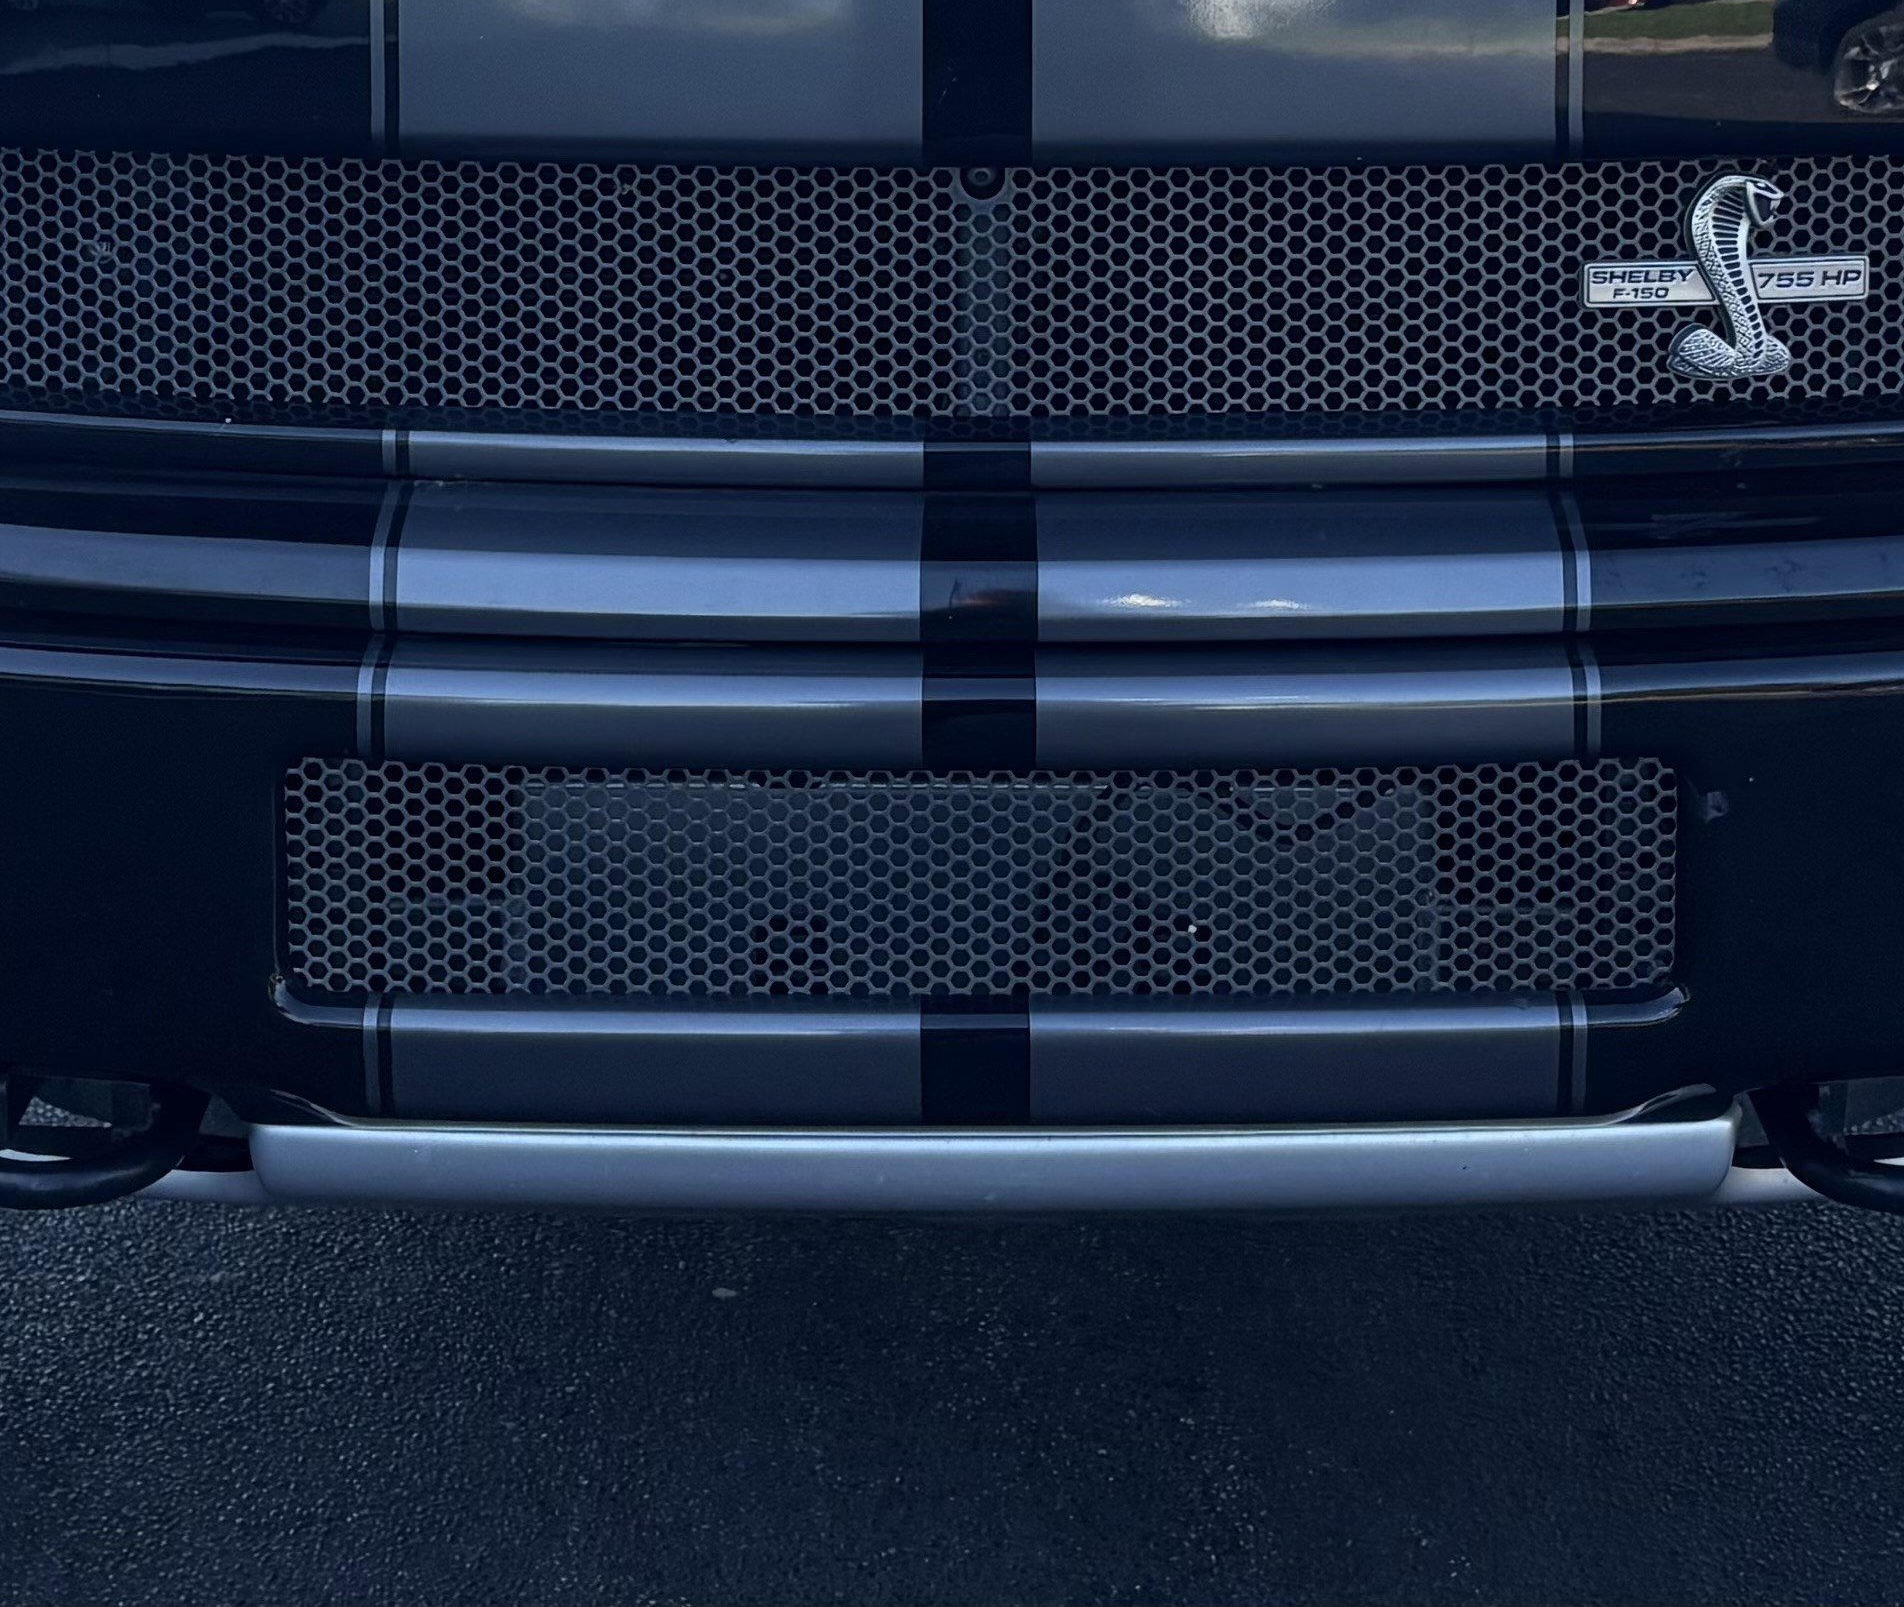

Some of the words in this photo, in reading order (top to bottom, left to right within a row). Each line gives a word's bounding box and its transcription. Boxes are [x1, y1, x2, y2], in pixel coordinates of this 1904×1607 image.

[1591, 268, 1695, 285] SHELBY
[1757, 271, 1815, 289] 755
[1820, 269, 1863, 287] HP
[1613, 287, 1670, 300] F-150
